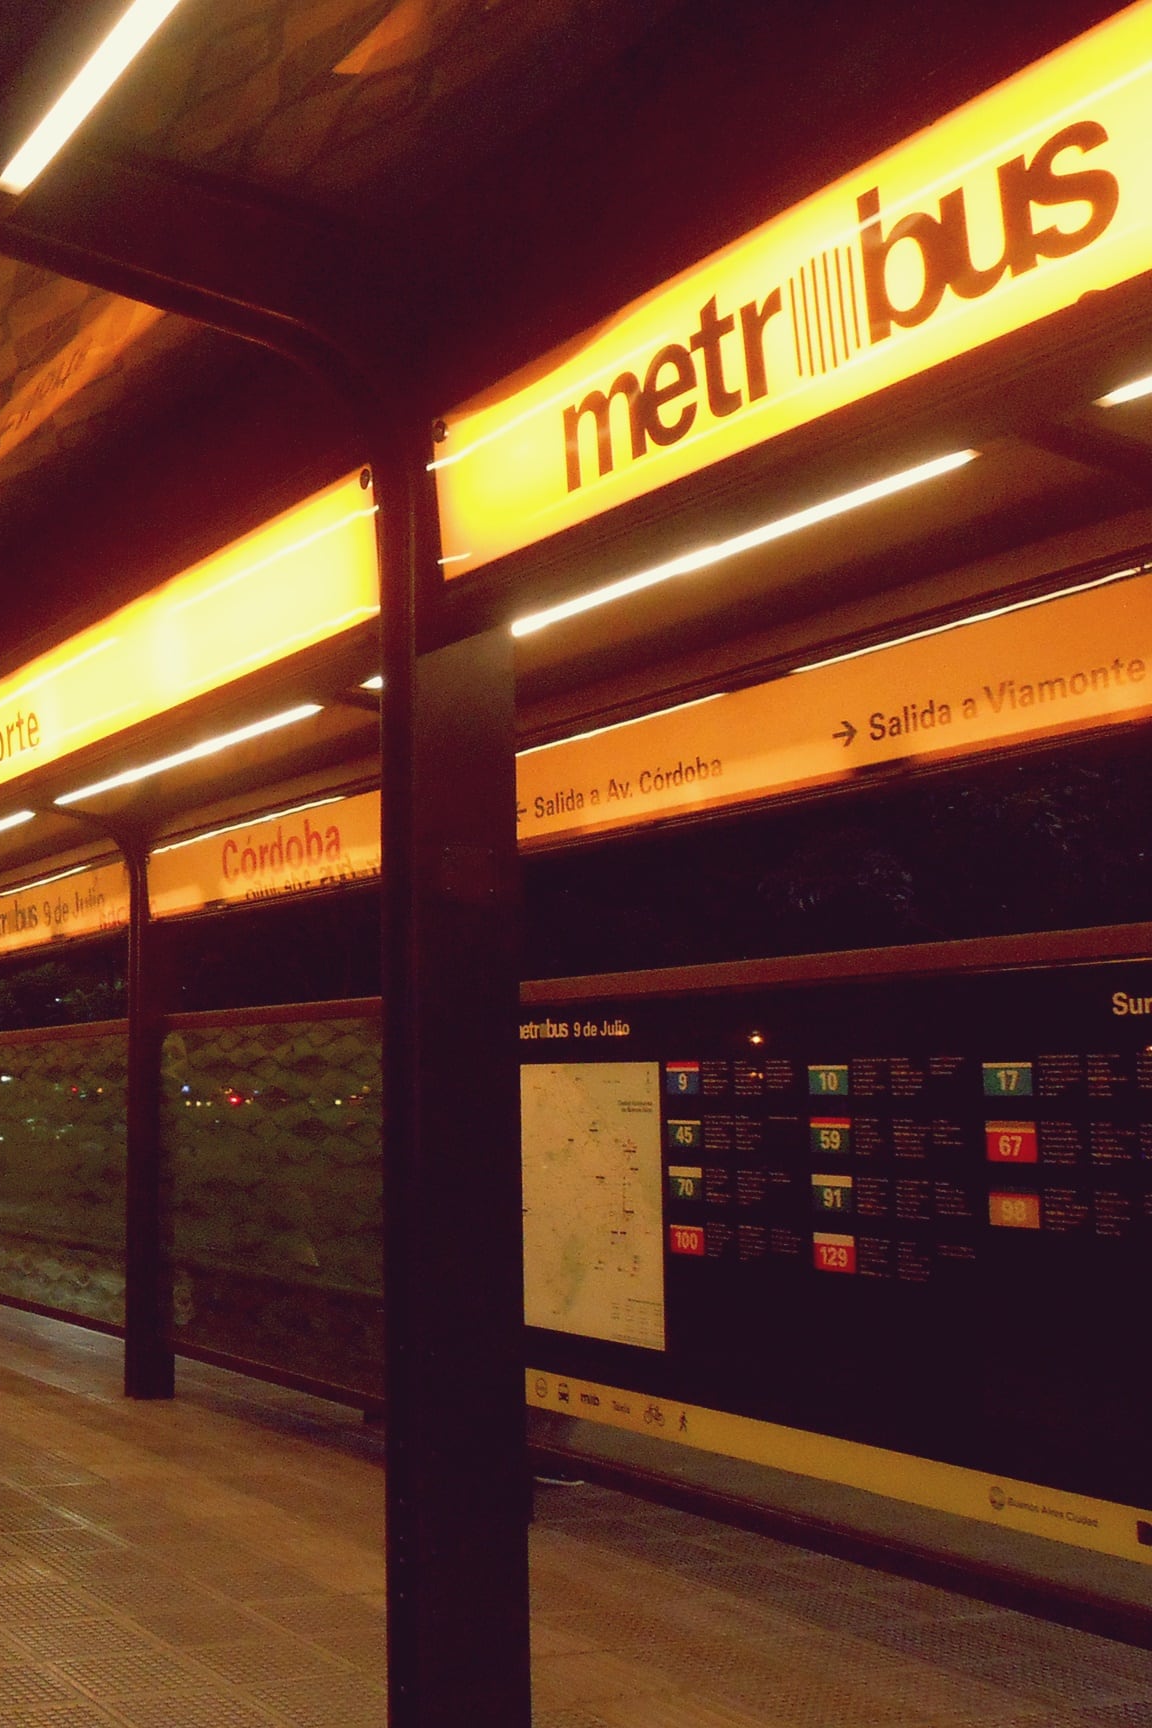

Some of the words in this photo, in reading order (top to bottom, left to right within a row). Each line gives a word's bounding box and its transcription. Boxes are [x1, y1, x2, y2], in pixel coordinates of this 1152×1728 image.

[868, 699, 952, 742] Salida
[961, 696, 978, 720] a
[984, 657, 1146, 714] Viamonte
[534, 787, 585, 819] Salida
[590, 788, 601, 805] a
[606, 778, 634, 803] Av.
[639, 756, 723, 795] Córdoba
[222, 818, 341, 883] Córdoba
[43, 900, 52, 927] 9
[54, 896, 69, 924] de
[73, 888, 105, 919] Julio
[573, 1021, 582, 1038] 9
[583, 1020, 597, 1037] de
[600, 1019, 630, 1036] Julio
[678, 1072, 688, 1091] 9
[818, 1071, 839, 1091] 10
[997, 1070, 1020, 1091] 17
[675, 1125, 694, 1144] 45
[820, 1129, 841, 1150] 59
[999, 1135, 1023, 1157] 67
[677, 1178, 694, 1197] 70
[822, 1187, 842, 1208] 91
[674, 1230, 698, 1251] 100
[819, 1246, 848, 1268] 129
